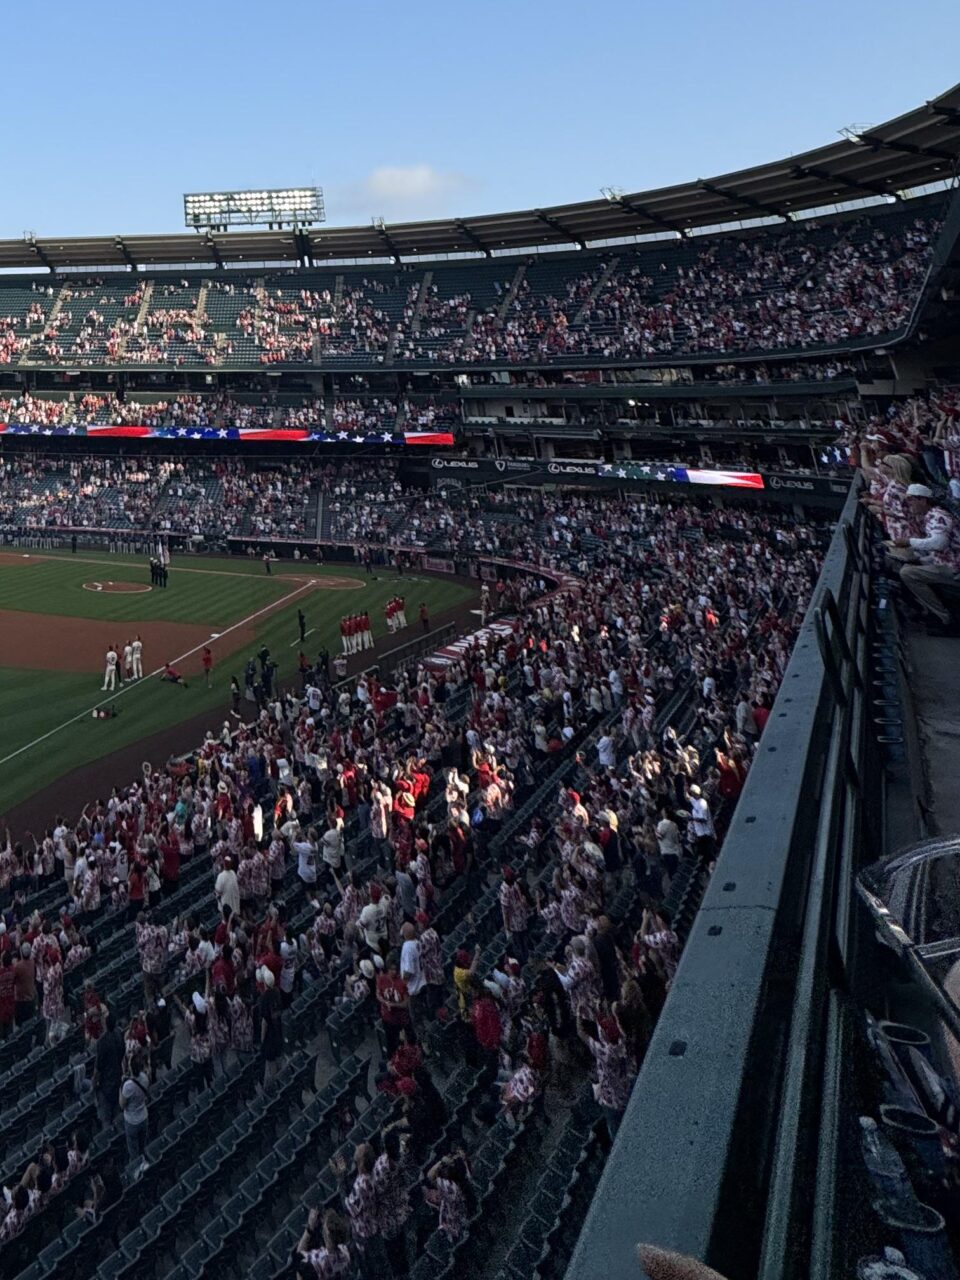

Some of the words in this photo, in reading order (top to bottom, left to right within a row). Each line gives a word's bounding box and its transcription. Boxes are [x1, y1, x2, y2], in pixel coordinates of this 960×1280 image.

[444, 460, 478, 468] LEXUS
[560, 466, 596, 474] LEXUS
[781, 480, 814, 490] LEXUS
